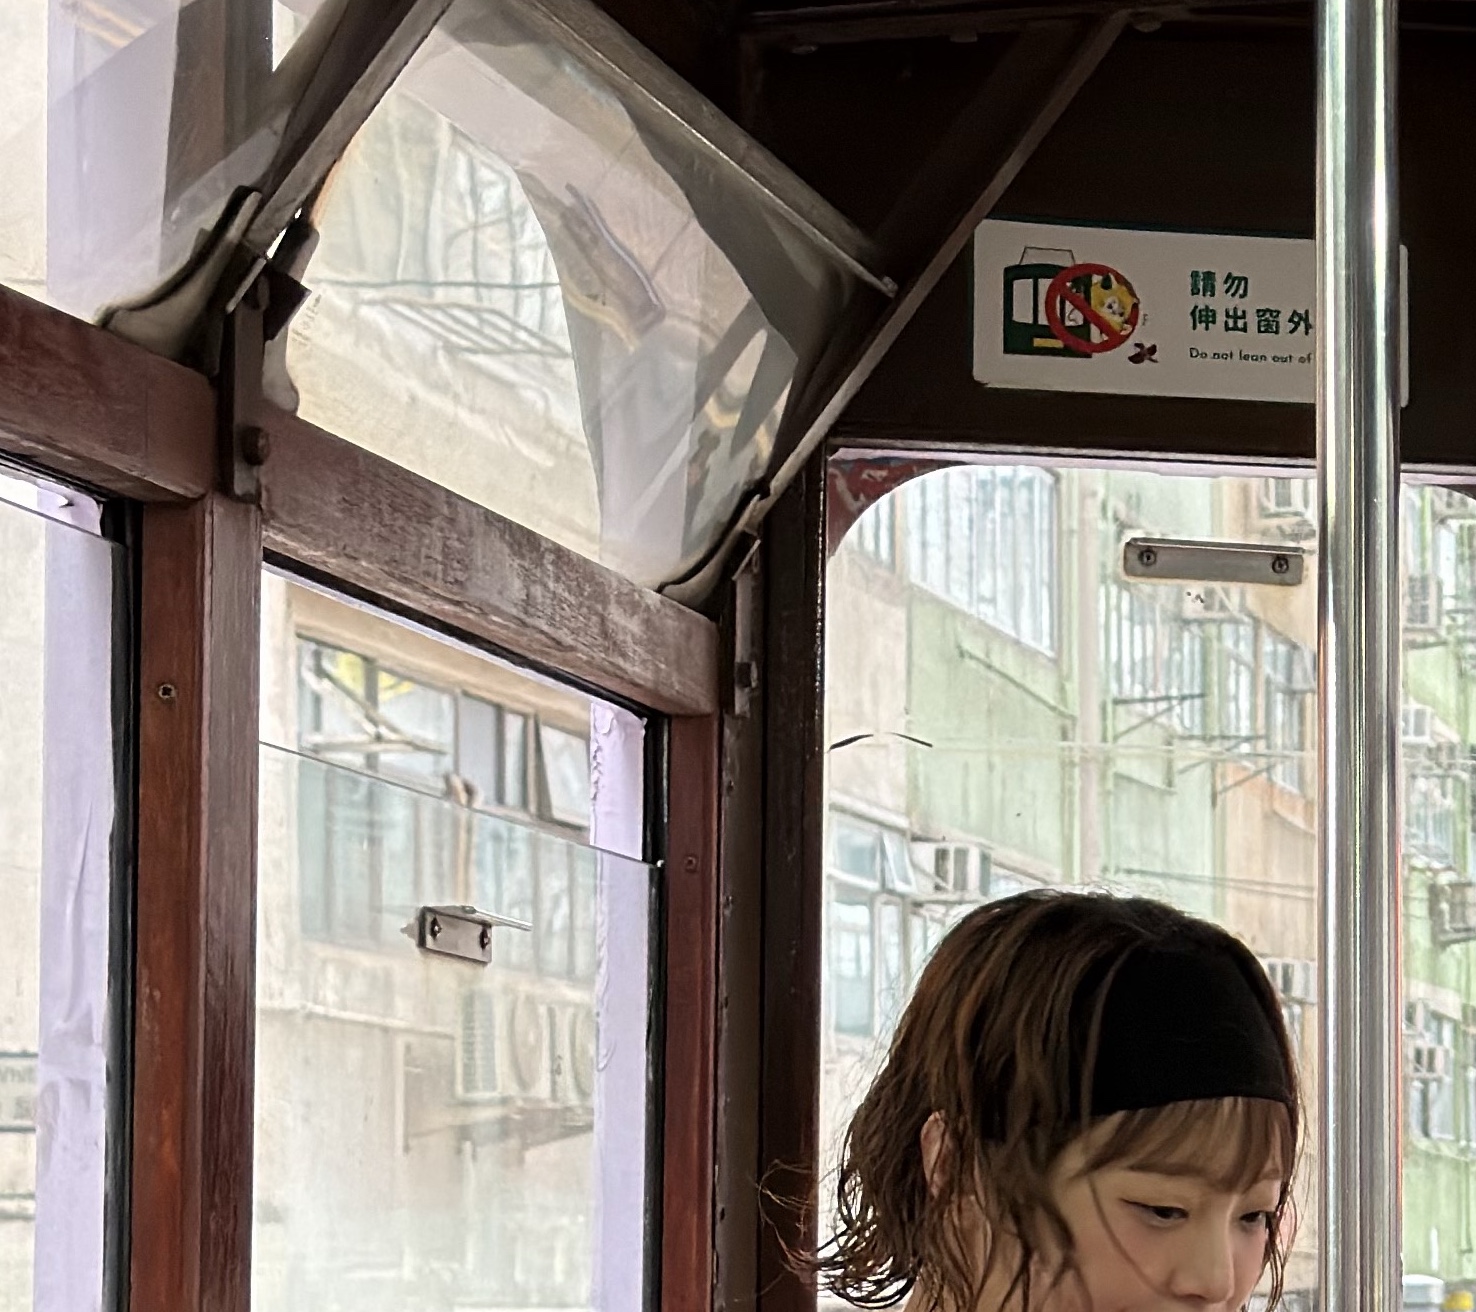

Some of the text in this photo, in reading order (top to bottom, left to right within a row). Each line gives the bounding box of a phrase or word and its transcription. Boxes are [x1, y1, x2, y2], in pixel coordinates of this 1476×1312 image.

[1190, 270, 1249, 299] 請勿
[1189, 304, 1313, 336] 伸出窗外
[1189, 347, 1313, 364] Do not lean out of
